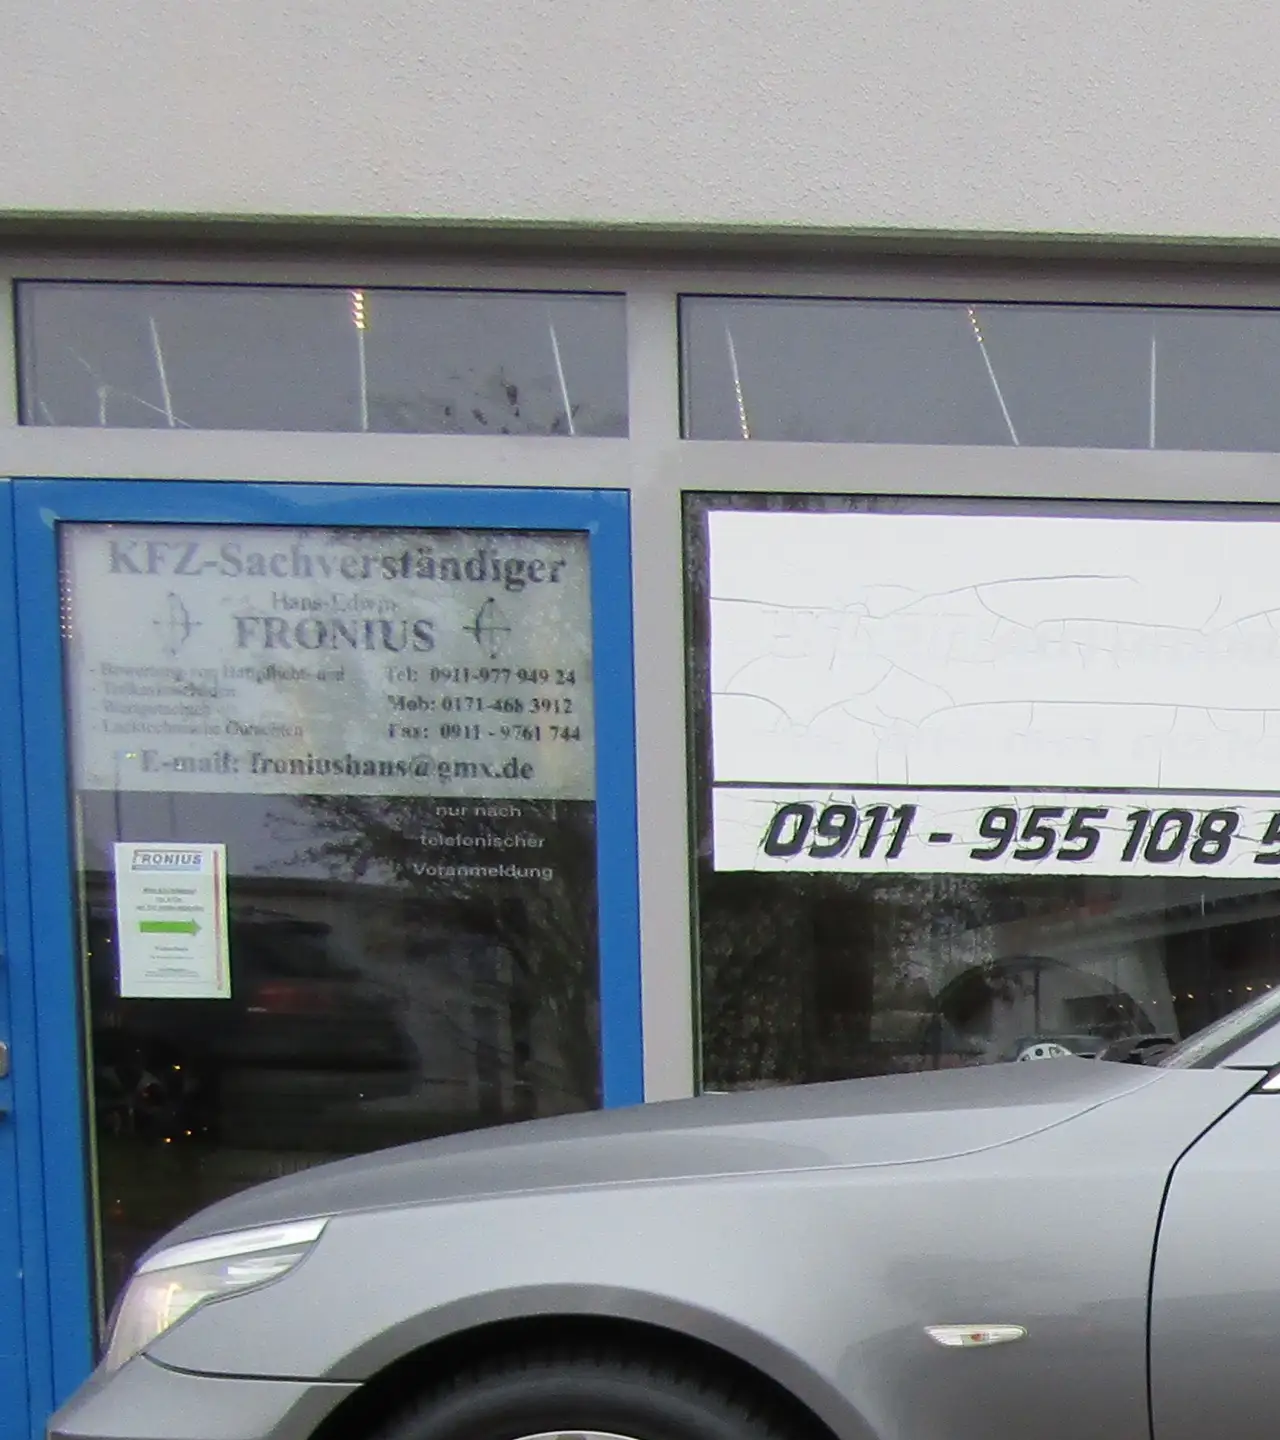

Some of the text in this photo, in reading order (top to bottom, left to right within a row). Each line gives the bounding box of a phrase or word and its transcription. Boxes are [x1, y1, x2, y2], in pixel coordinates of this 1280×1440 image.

[107, 540, 567, 592] KFZ-Sachverständiger
[232, 615, 436, 652] FRONIUS
[555, 669, 576, 687] 24
[436, 805, 523, 818] nur nach
[420, 833, 547, 849] telefonischer
[762, 803, 918, 860] 0911
[970, 808, 1108, 862] 955
[1120, 808, 1240, 866] 108
[412, 862, 554, 882] Voranmeldung
